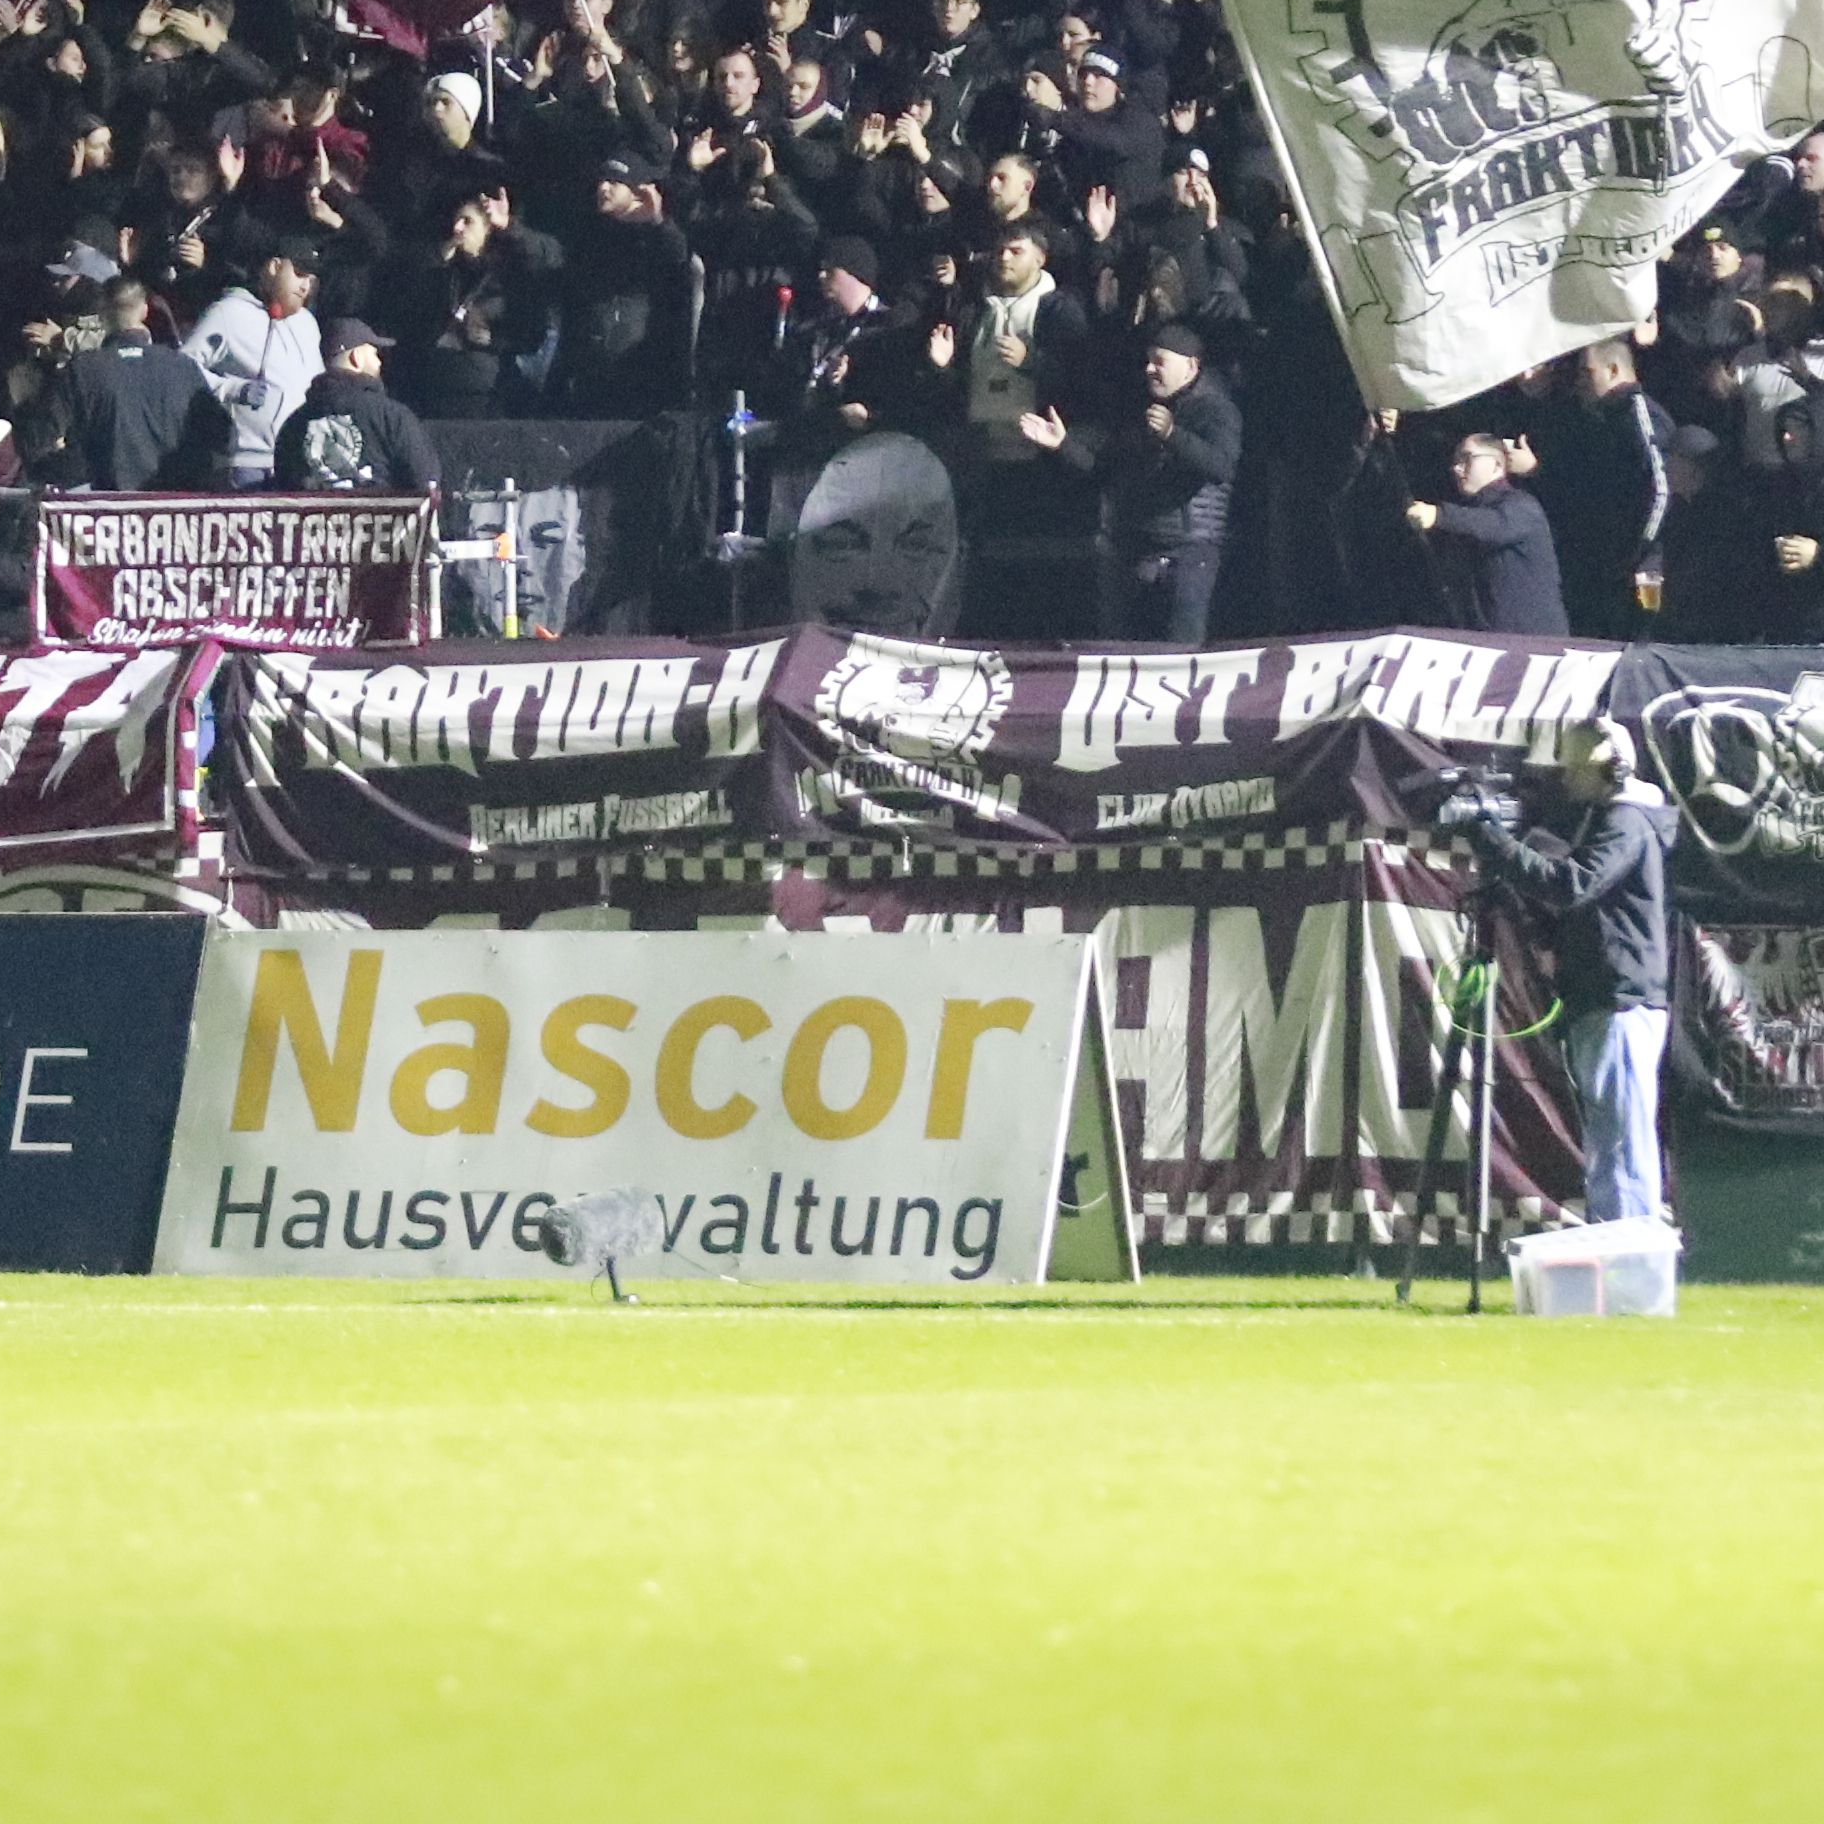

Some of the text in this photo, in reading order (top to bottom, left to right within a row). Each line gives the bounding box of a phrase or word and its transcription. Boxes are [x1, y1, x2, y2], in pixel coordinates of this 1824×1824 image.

[49, 511, 418, 567] VERBANDSSTRAFEN
[113, 566, 352, 620] ABSCHAFFEN
[230, 947, 1036, 1141] Nascor
[210, 1166, 1004, 1280] Hausvealtung
